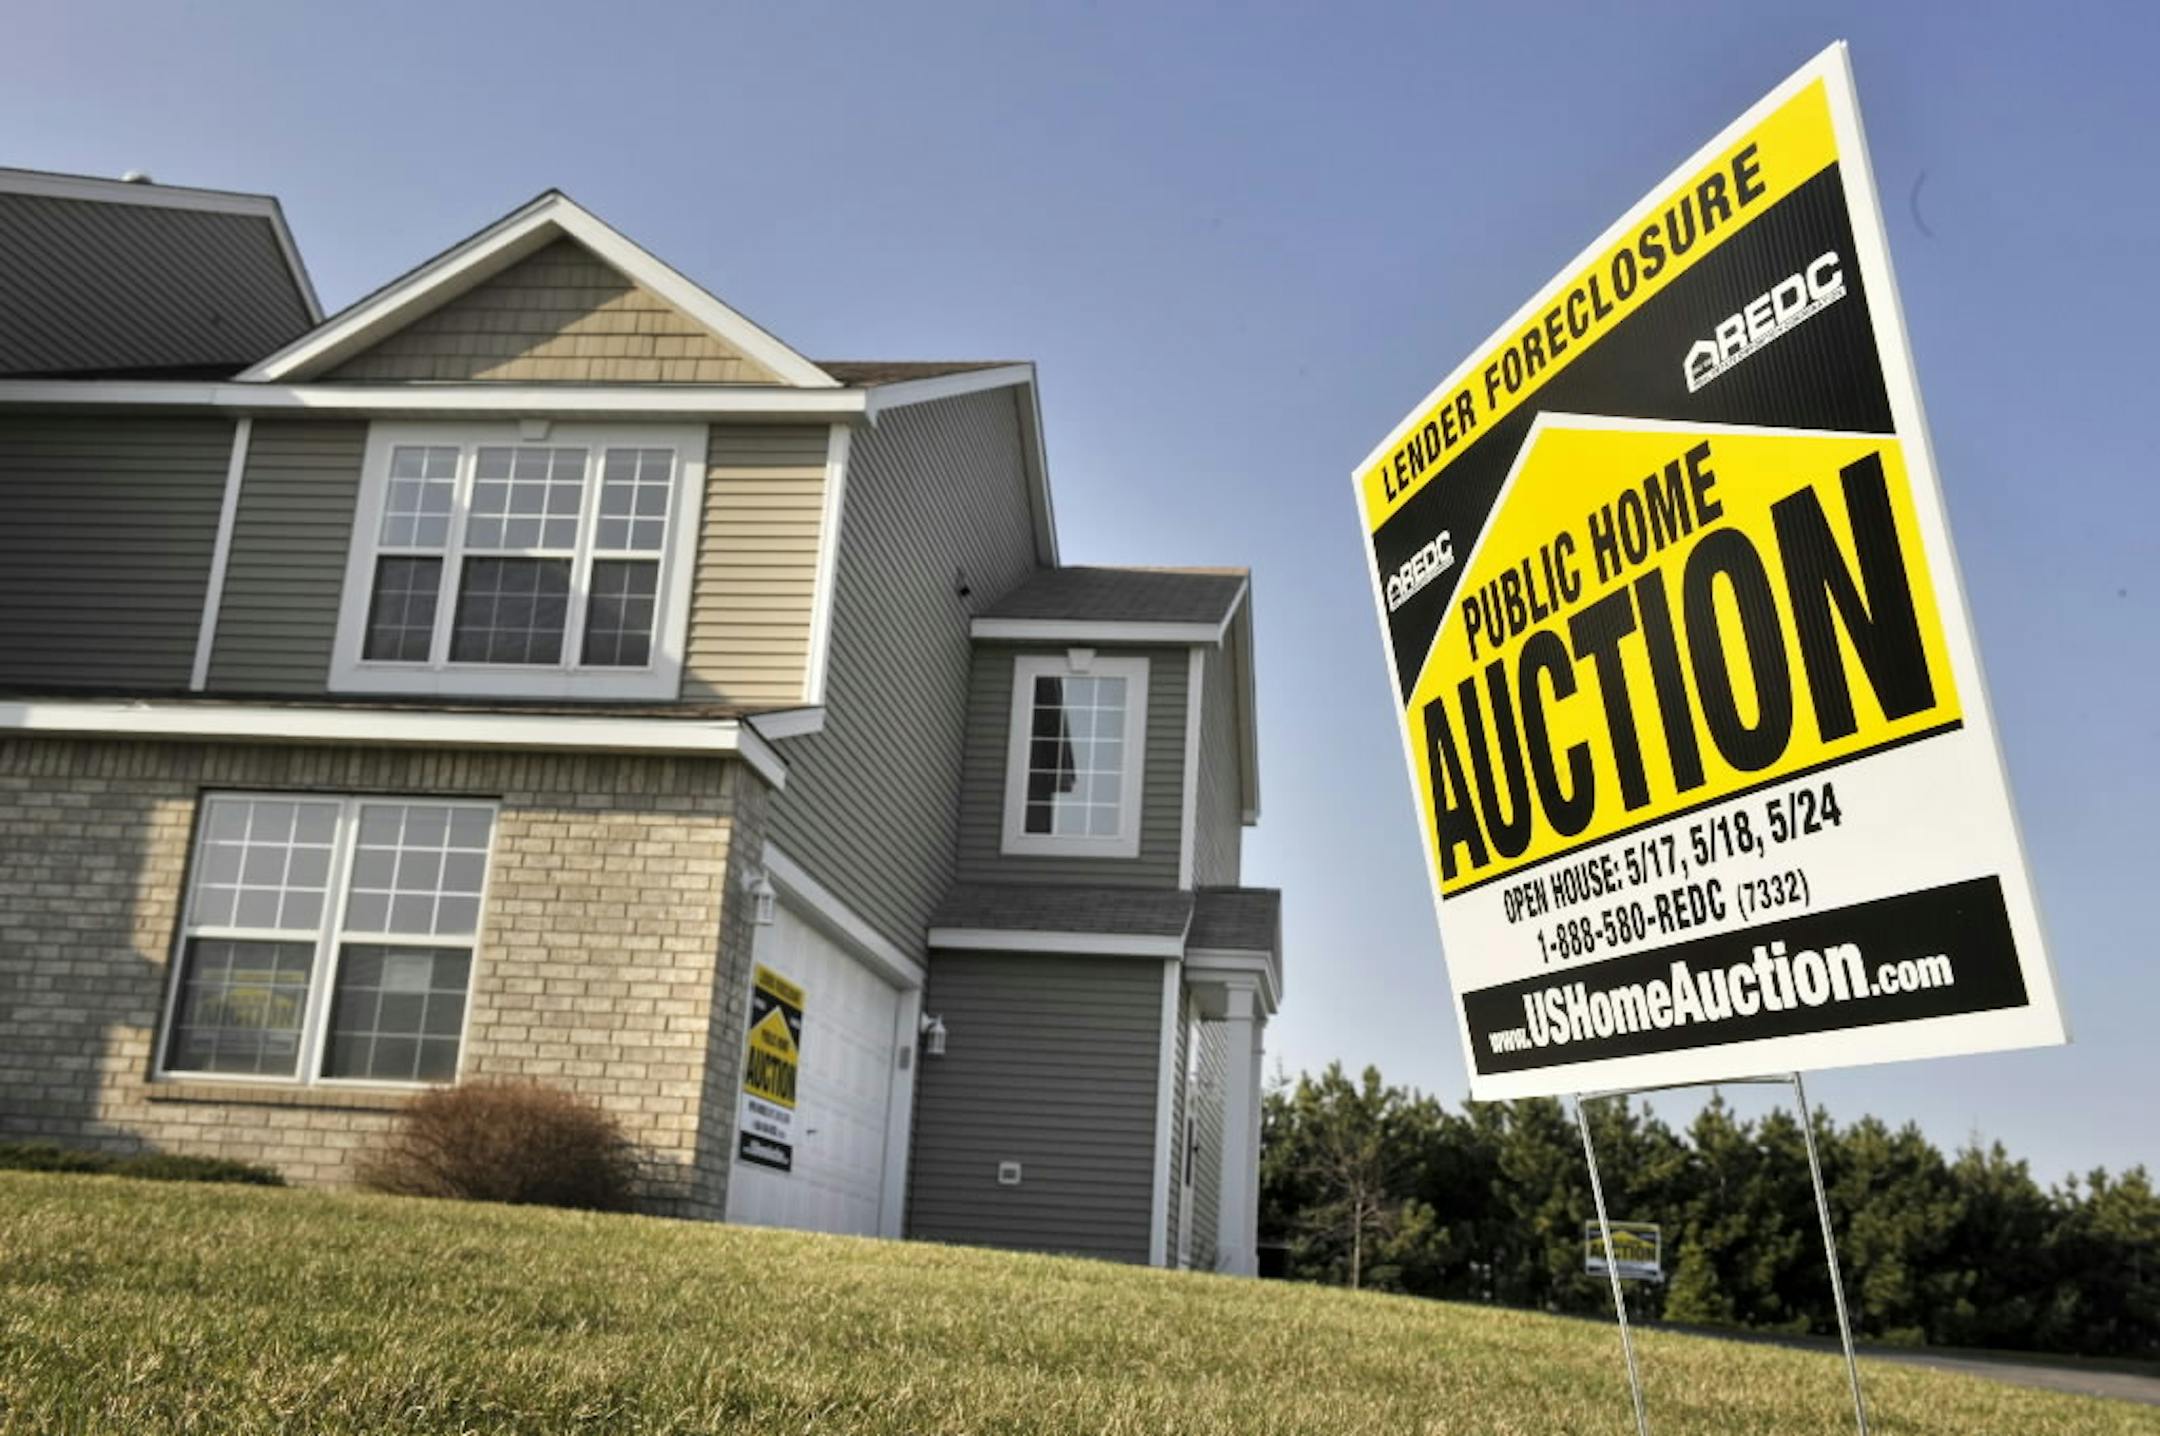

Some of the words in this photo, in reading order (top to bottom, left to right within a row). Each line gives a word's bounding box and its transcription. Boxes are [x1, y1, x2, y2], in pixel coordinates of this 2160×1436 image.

[1383, 387, 1478, 502] LENDER
[1484, 143, 1768, 410] FORECLOSURE
[1714, 251, 1844, 362] REDC
[1400, 529, 1453, 598] REDC
[1461, 531, 1582, 661] PUBLIC
[1587, 440, 1724, 585] HOME
[1421, 451, 1937, 881] AUCTION
[1503, 876, 1549, 925] OPEN
[1549, 853, 1624, 909] HOUSE:
[1623, 834, 1690, 885] 5/17,
[1690, 810, 1764, 867] 5/18,
[1765, 782, 1842, 844] 5/24
[1536, 878, 1728, 963] 1-888-580-REDC
[1737, 868, 1811, 923] (7332)
[1488, 941, 1955, 1054] www.USHomeAuction.com
